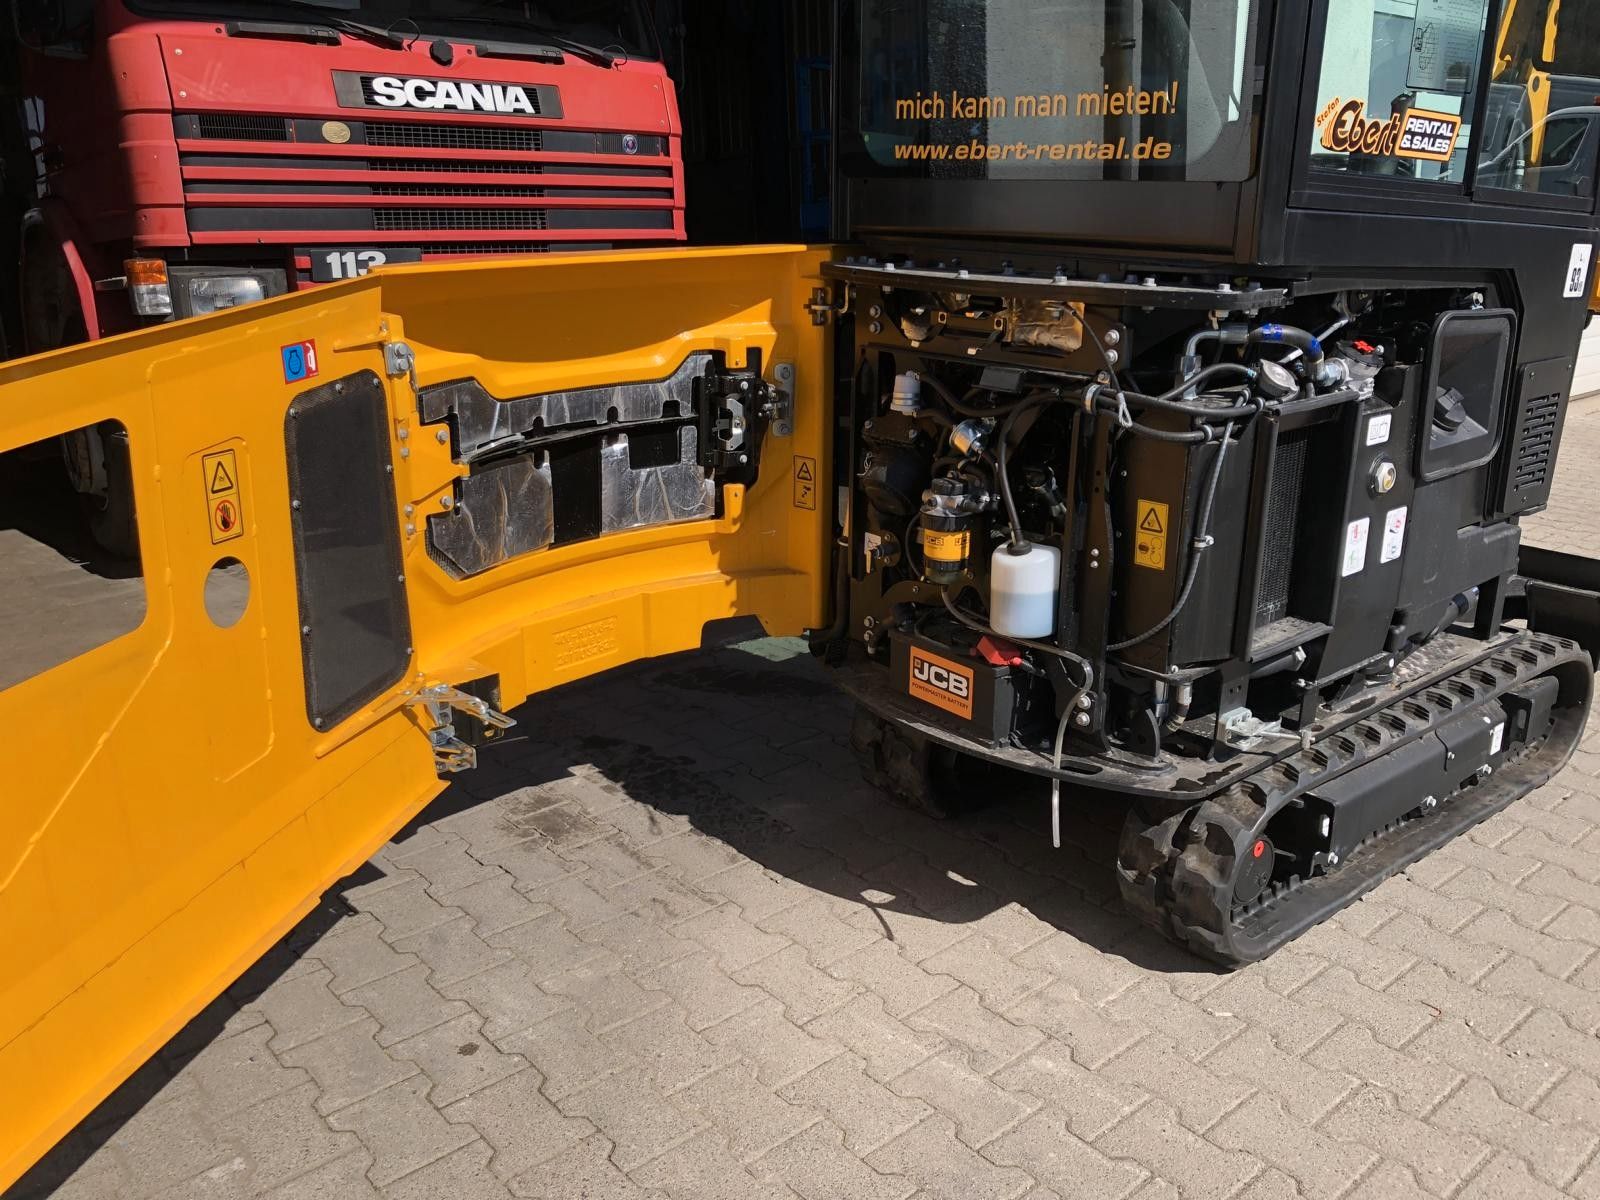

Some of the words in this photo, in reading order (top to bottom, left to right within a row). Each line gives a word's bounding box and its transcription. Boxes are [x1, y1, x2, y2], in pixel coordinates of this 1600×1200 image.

[371, 76, 536, 114] SCANIA
[895, 91, 945, 120] mich
[951, 90, 1006, 119] kann
[1014, 92, 1067, 118] man
[1076, 80, 1179, 116] mieten!
[1316, 97, 1340, 127] Stefan
[1332, 98, 1400, 155] Ebert
[1405, 118, 1453, 136] RENTAL
[894, 136, 1173, 160] www.ebert-rental.de
[913, 658, 969, 698] JCB
[911, 681, 947, 700] POWERMASTER
[947, 696, 969, 711] BATTERY
